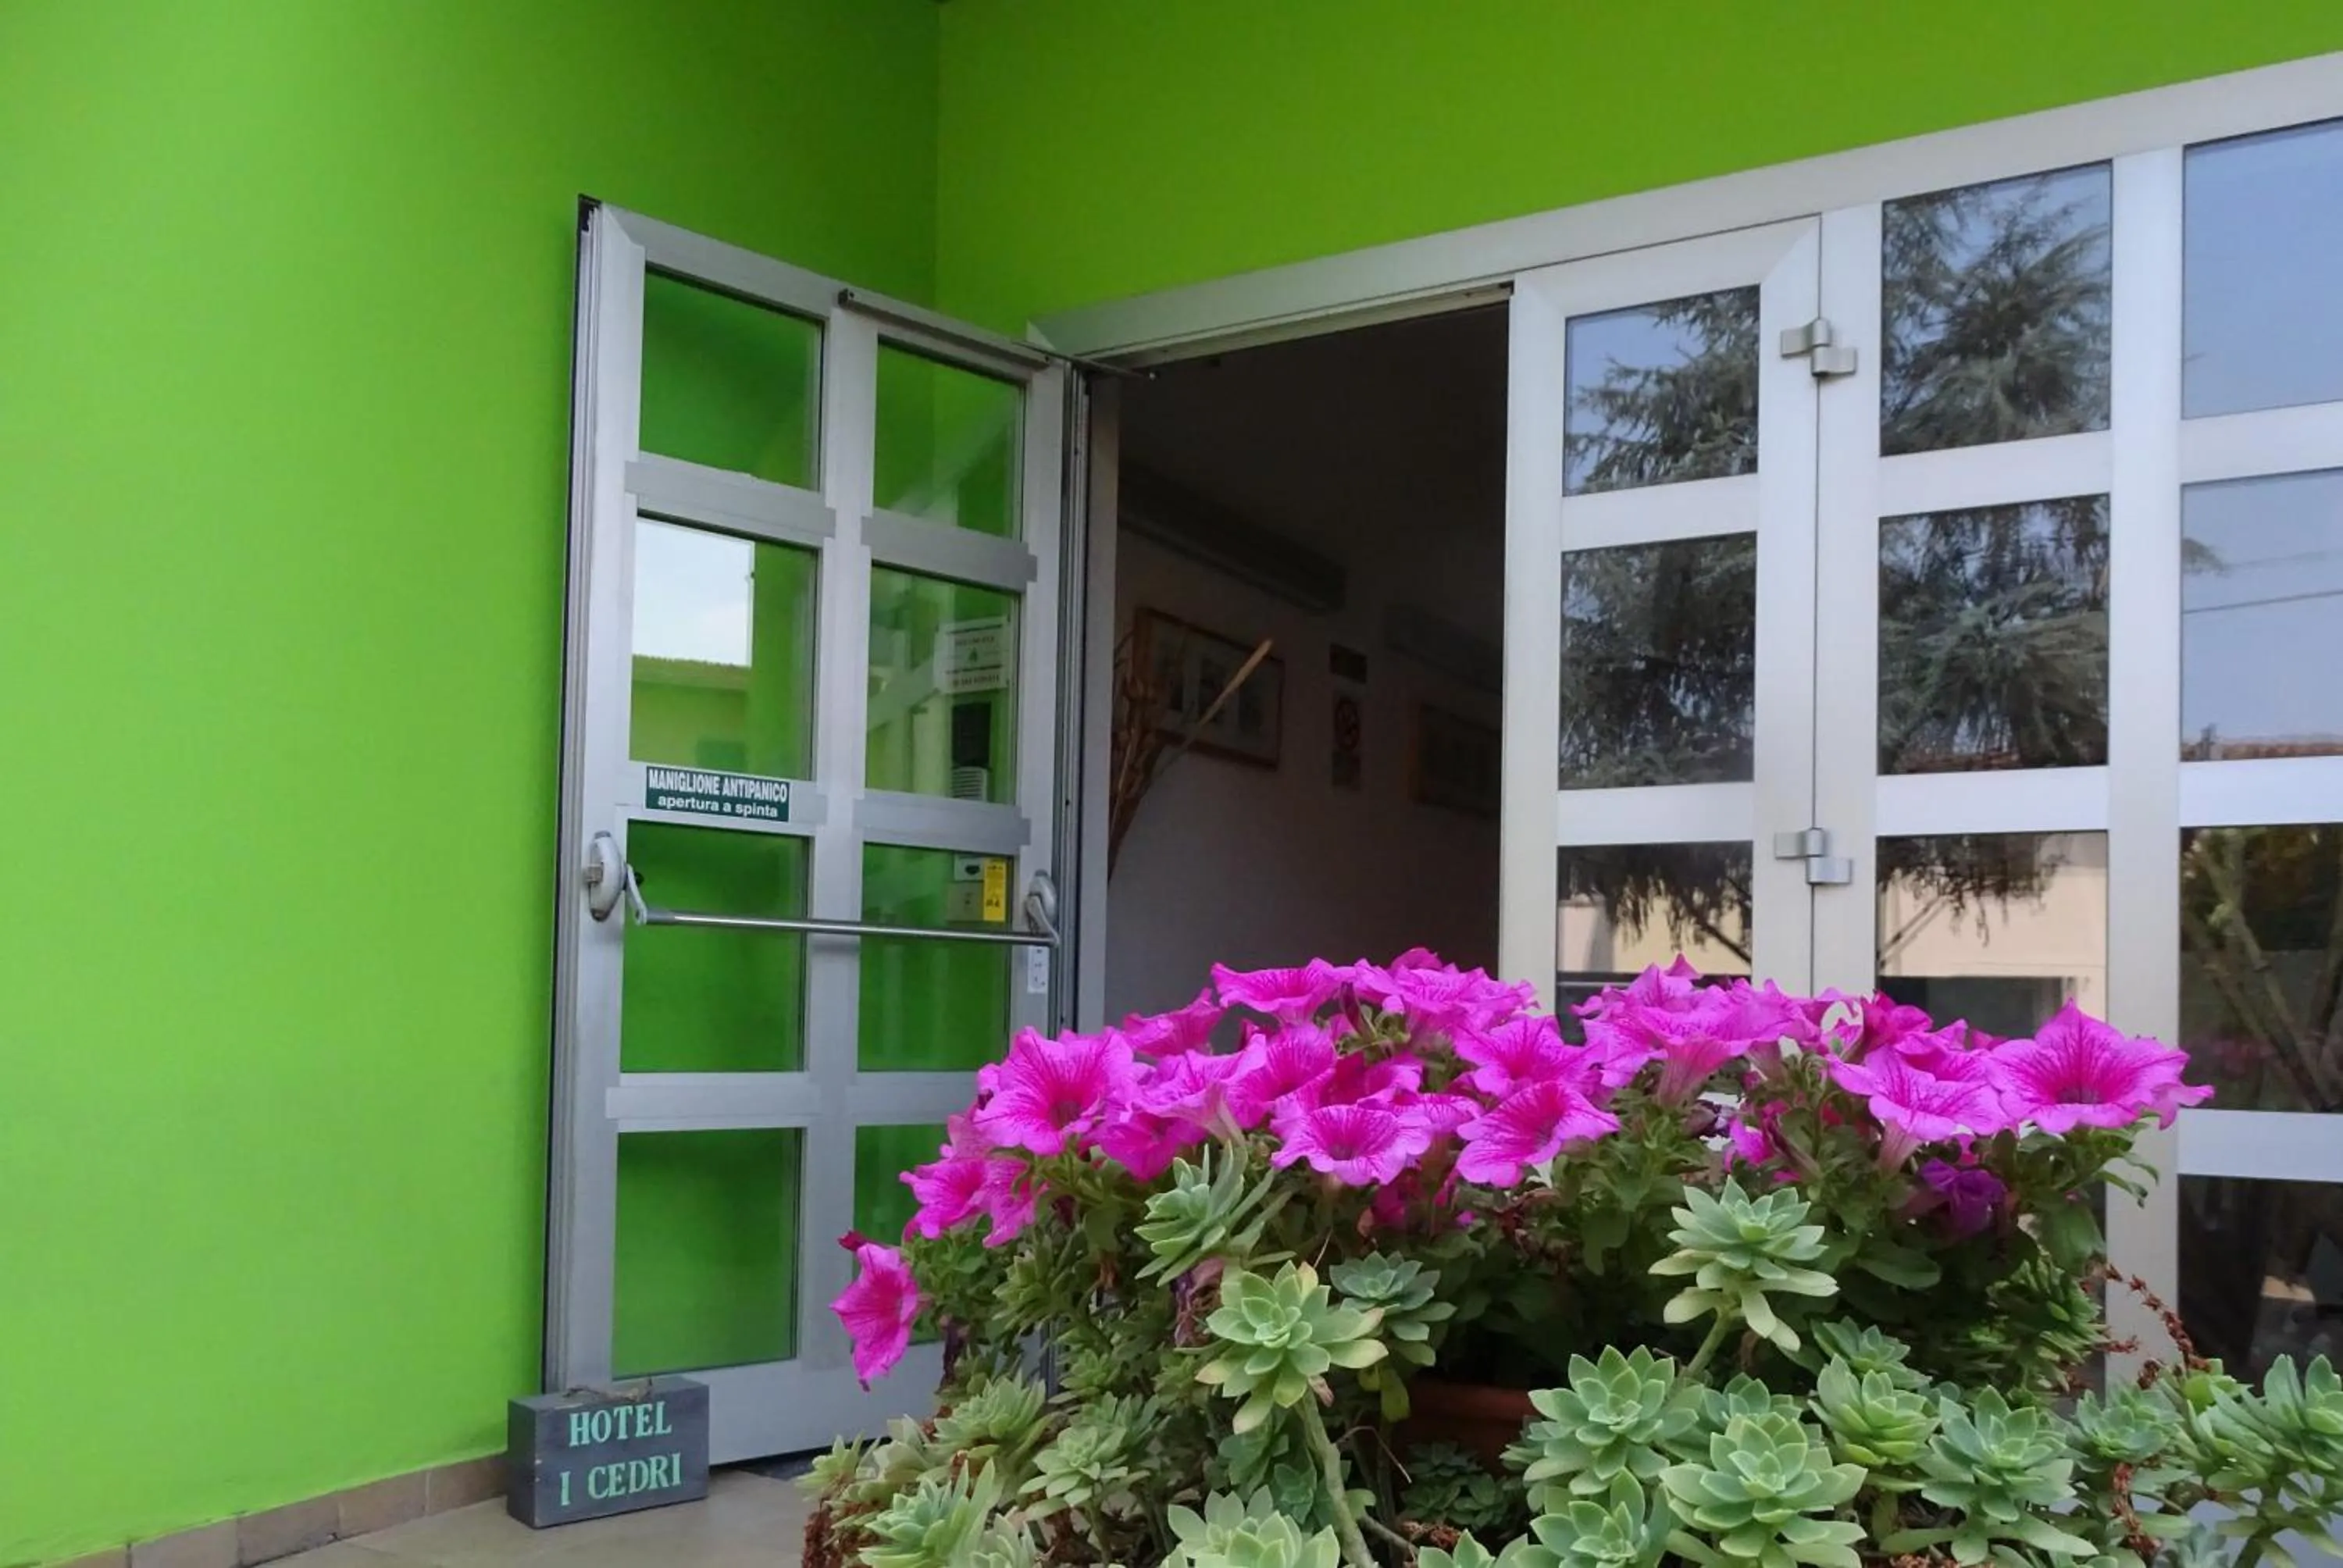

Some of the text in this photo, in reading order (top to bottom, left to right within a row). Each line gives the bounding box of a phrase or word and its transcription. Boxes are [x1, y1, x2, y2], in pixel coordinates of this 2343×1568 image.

[648, 768, 787, 803] MANIGLIONE ANTIPANICO
[658, 795, 778, 818] apertura a spinta
[569, 1401, 672, 1447] HOTEL
[560, 1452, 682, 1506] I CEDRI
